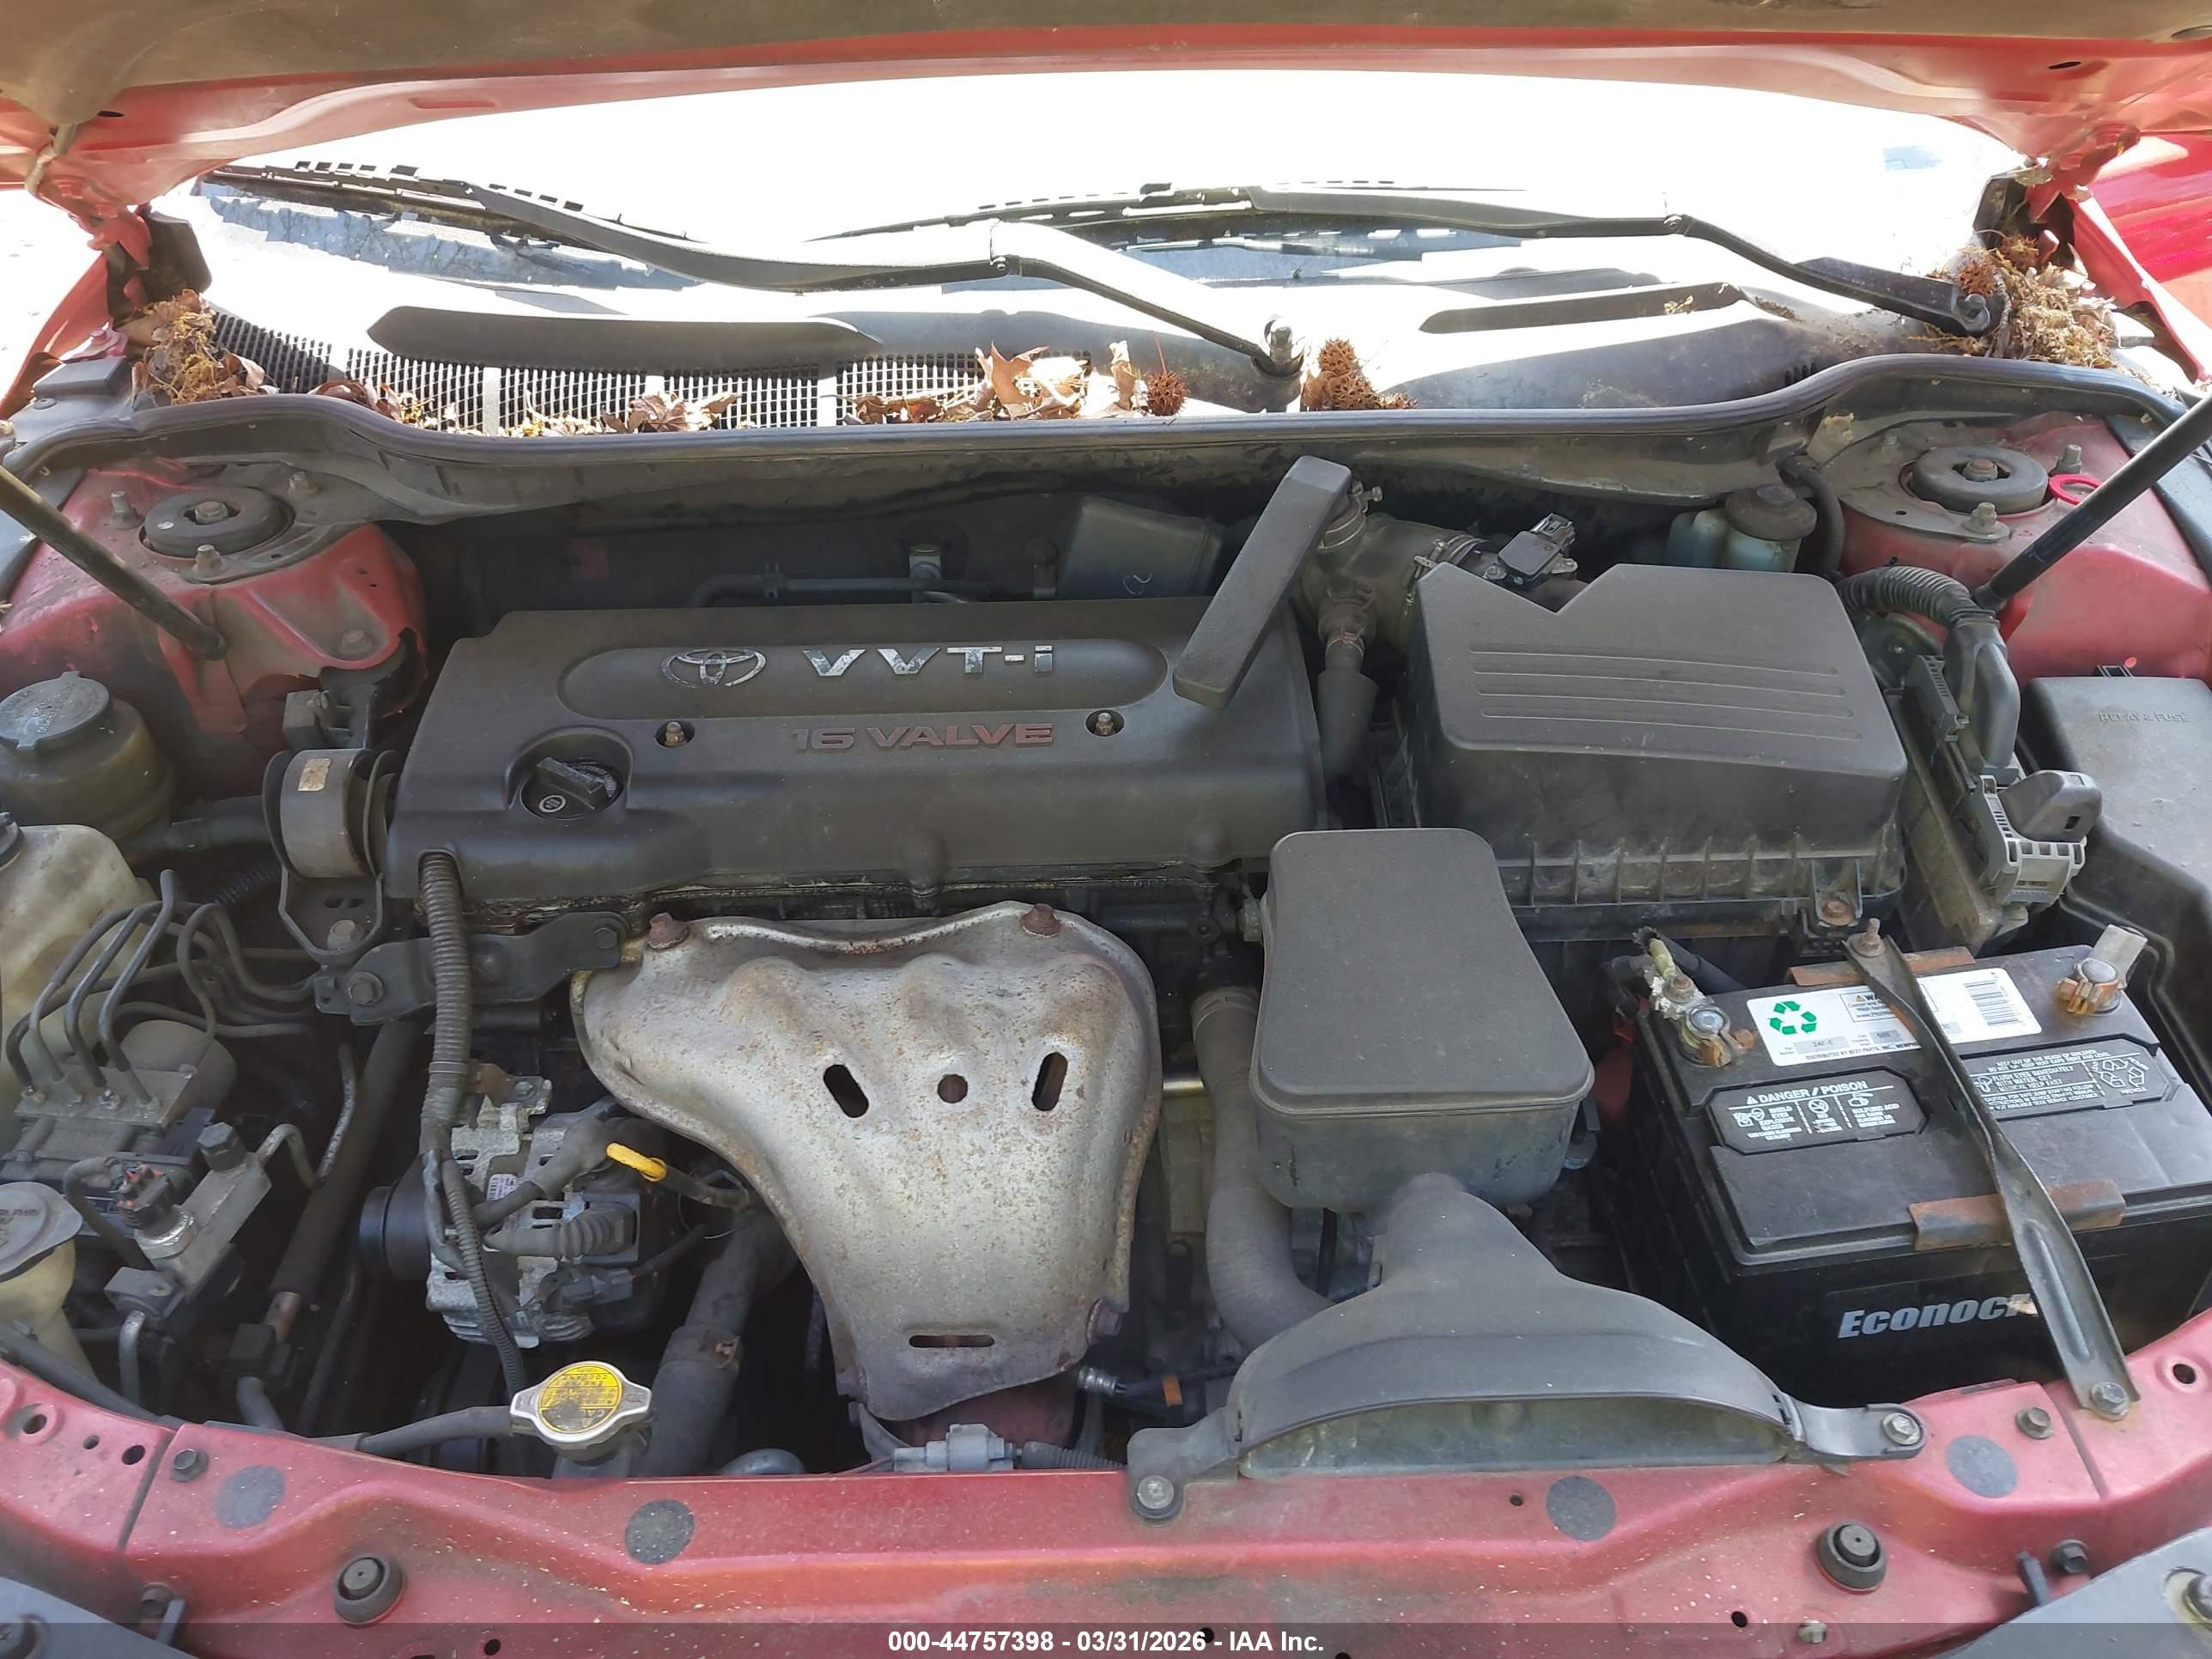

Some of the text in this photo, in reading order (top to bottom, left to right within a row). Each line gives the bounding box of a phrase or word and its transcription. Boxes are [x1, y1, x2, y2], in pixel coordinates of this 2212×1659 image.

[803, 645, 1053, 677] VVT-i
[2155, 713, 2191, 722] FUSE
[793, 723, 1054, 750] 16 VALVE
[1758, 1088, 1811, 1103] DANGER
[1820, 1080, 1869, 1095] POISON
